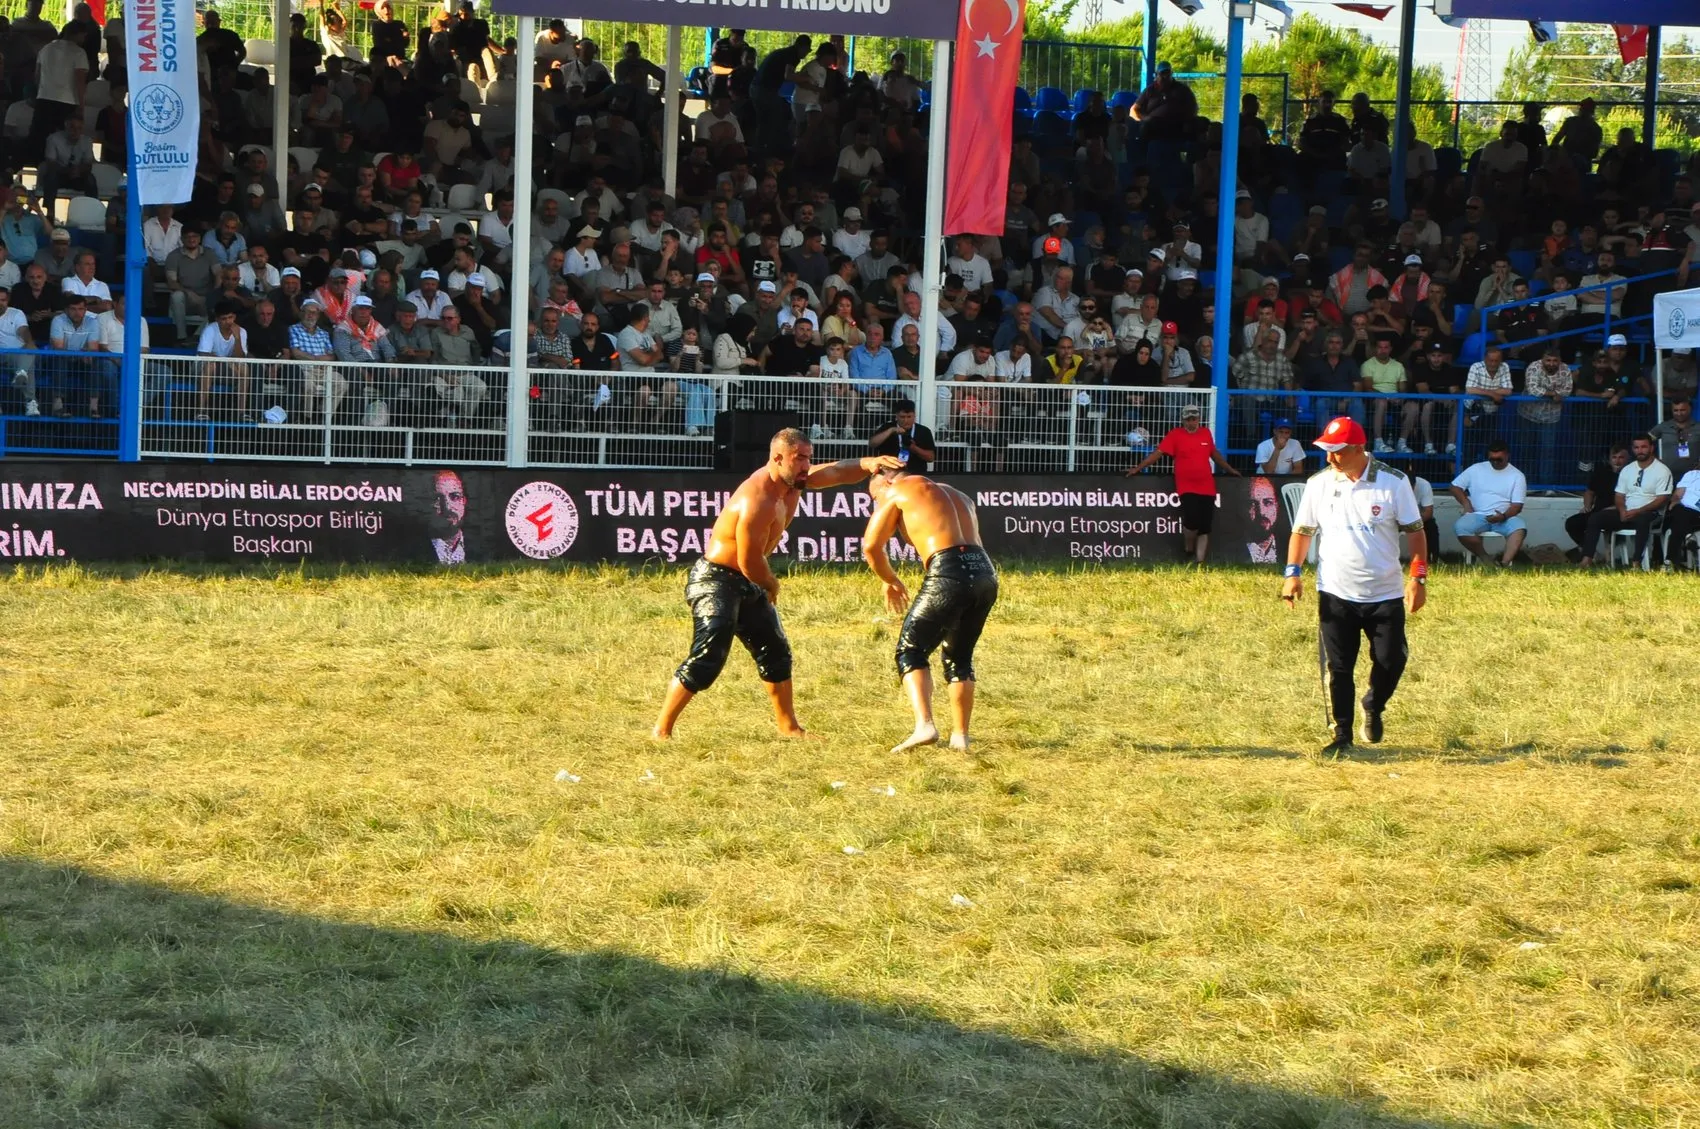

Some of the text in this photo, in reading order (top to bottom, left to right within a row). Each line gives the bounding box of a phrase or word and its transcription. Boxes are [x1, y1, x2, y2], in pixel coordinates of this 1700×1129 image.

[160, 0, 178, 73] SÖZÜM
[144, 142, 177, 154] Besim
[123, 479, 402, 502] NECMEDDİN BİLAL ERDOĞAN
[585, 483, 655, 517] TÜM
[976, 487, 1082, 507] NECMEDDİN
[1085, 488, 1133, 507] BİLAL
[507, 488, 531, 518] DÜNYA
[157, 508, 383, 534] Dünya Etnospor Birliği
[1004, 515, 1065, 538] Dünya
[1070, 516, 1150, 538] Etnospor
[233, 535, 313, 558] Başkanı
[1070, 540, 1141, 563] Başkanı
